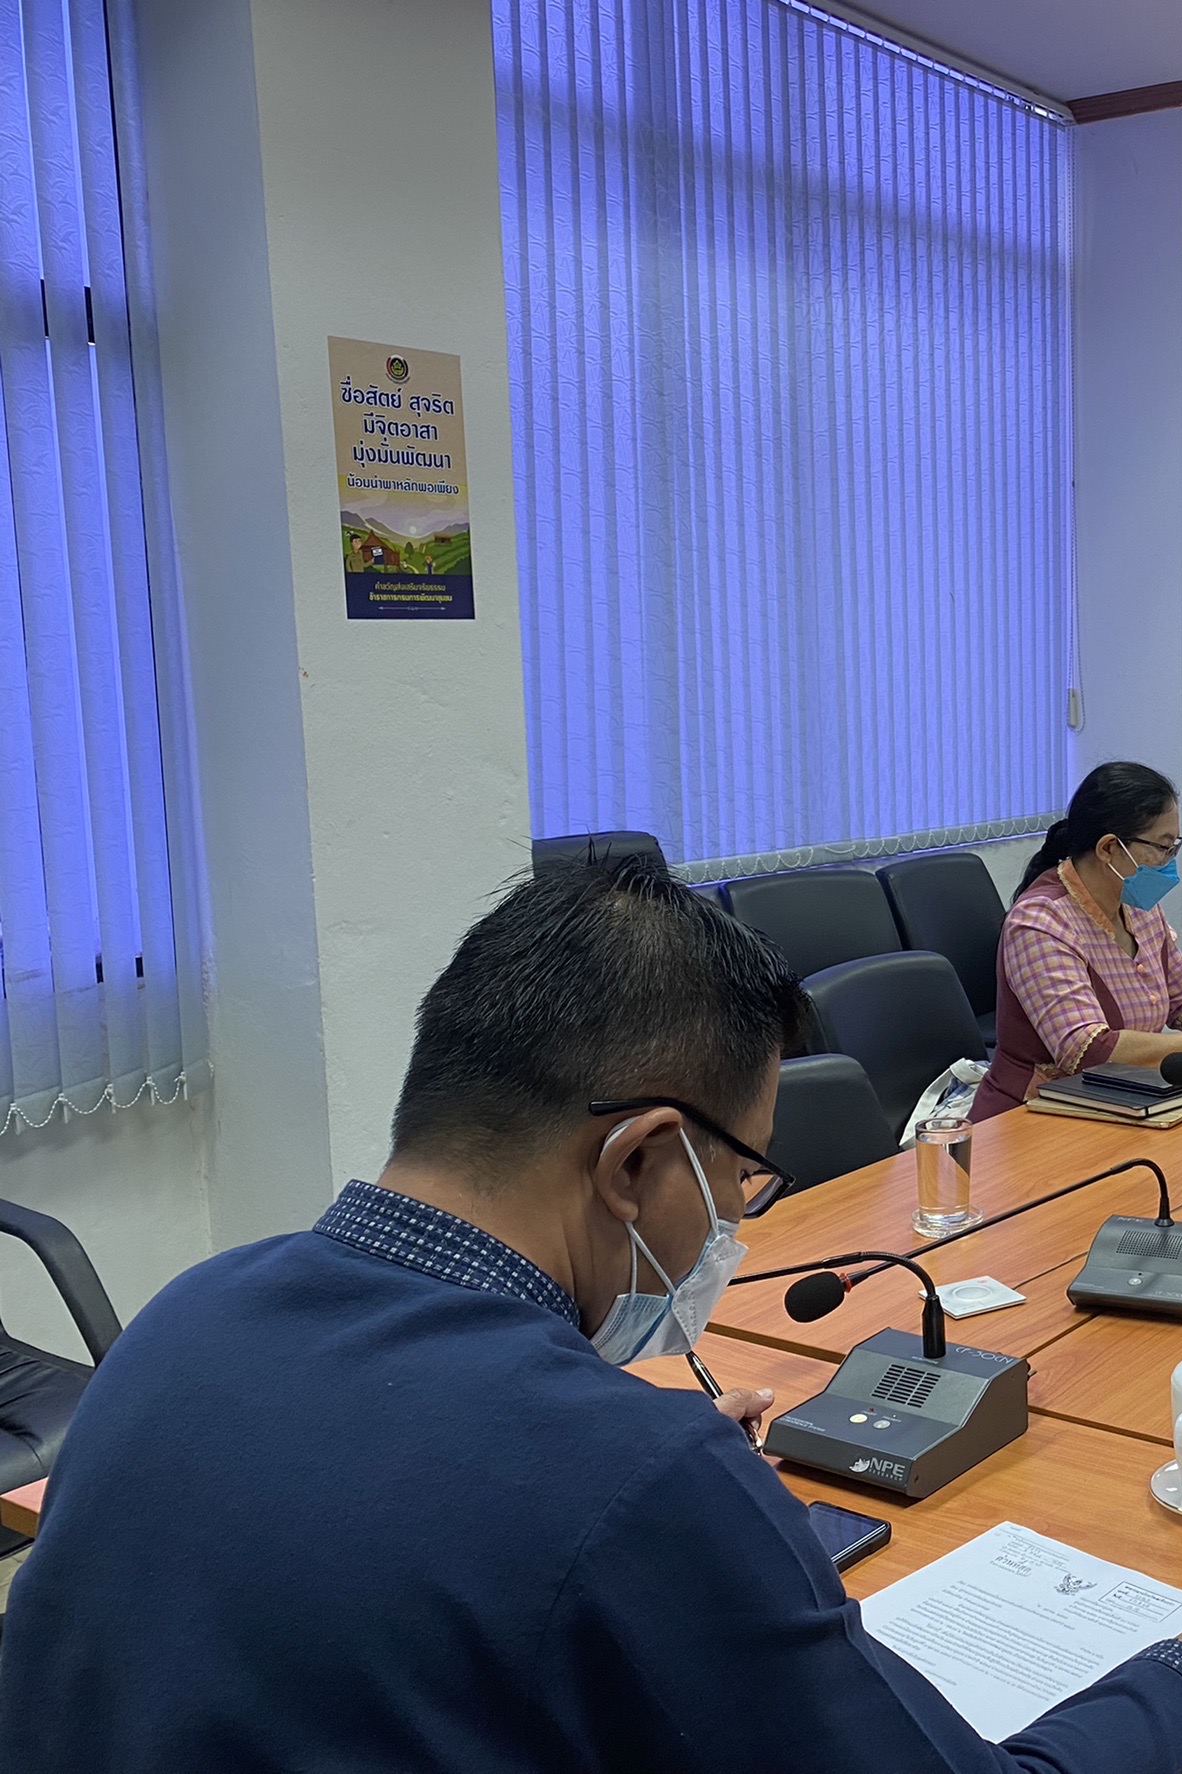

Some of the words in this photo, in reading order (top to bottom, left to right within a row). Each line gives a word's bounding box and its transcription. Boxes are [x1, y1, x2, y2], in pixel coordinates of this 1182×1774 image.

[340, 375, 402, 409] ซื่อสัตย์
[409, 393, 455, 418] สุจริต
[363, 412, 438, 440] มีจิตอาสา
[353, 437, 451, 469] มุ่งมั่นพัฒนา
[869, 1468, 903, 1482] RESEARCH
[870, 1457, 906, 1477] NPE
